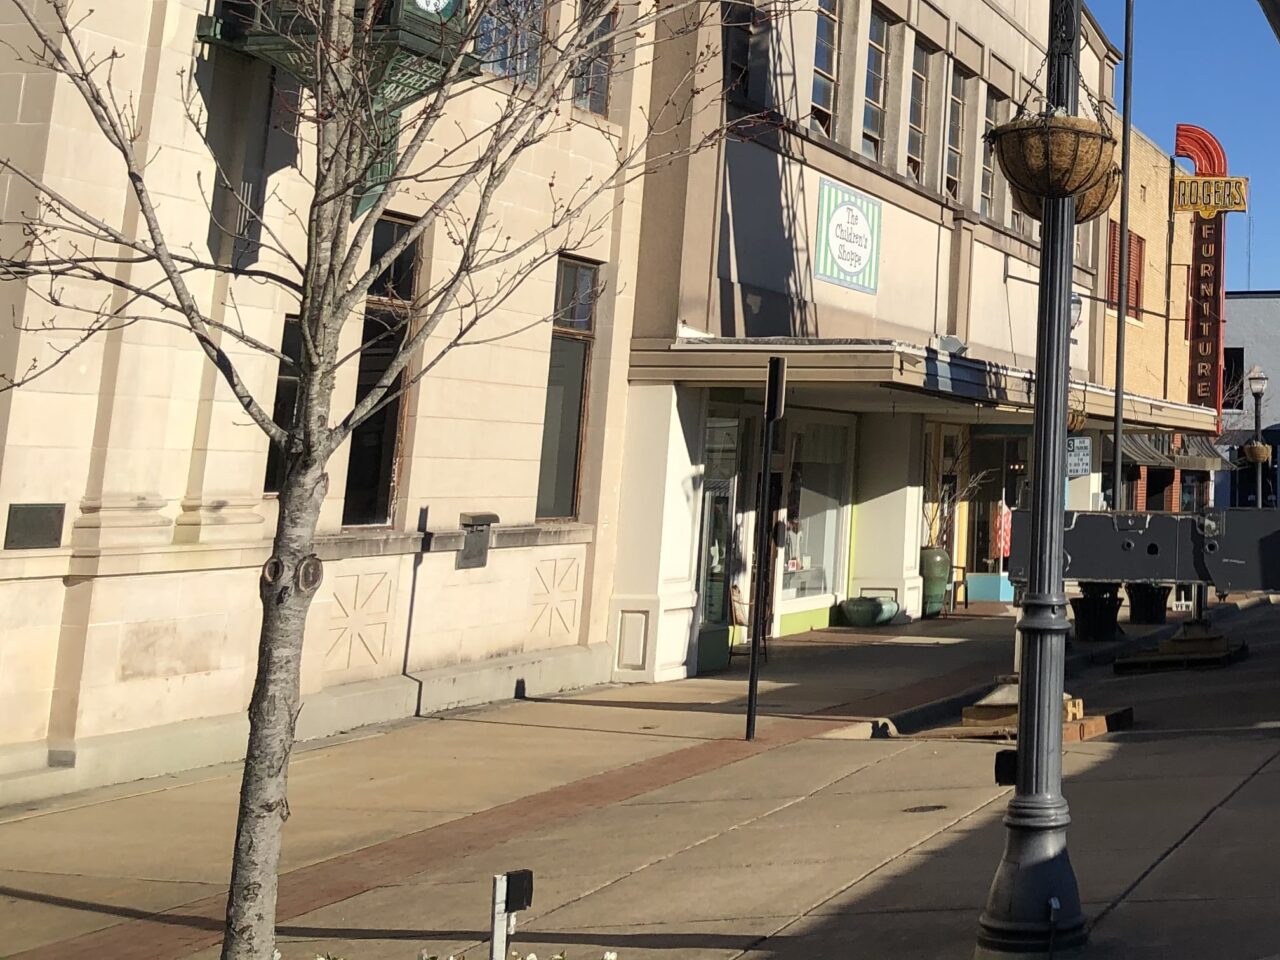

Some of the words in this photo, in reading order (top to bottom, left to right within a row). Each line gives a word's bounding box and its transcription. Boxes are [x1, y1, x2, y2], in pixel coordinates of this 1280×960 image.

[1178, 180, 1244, 206] ROGERS
[846, 206, 859, 226] The
[835, 223, 868, 249] Children's
[837, 243, 862, 268] Shoppe
[1196, 224, 1216, 398] FURNITURE
